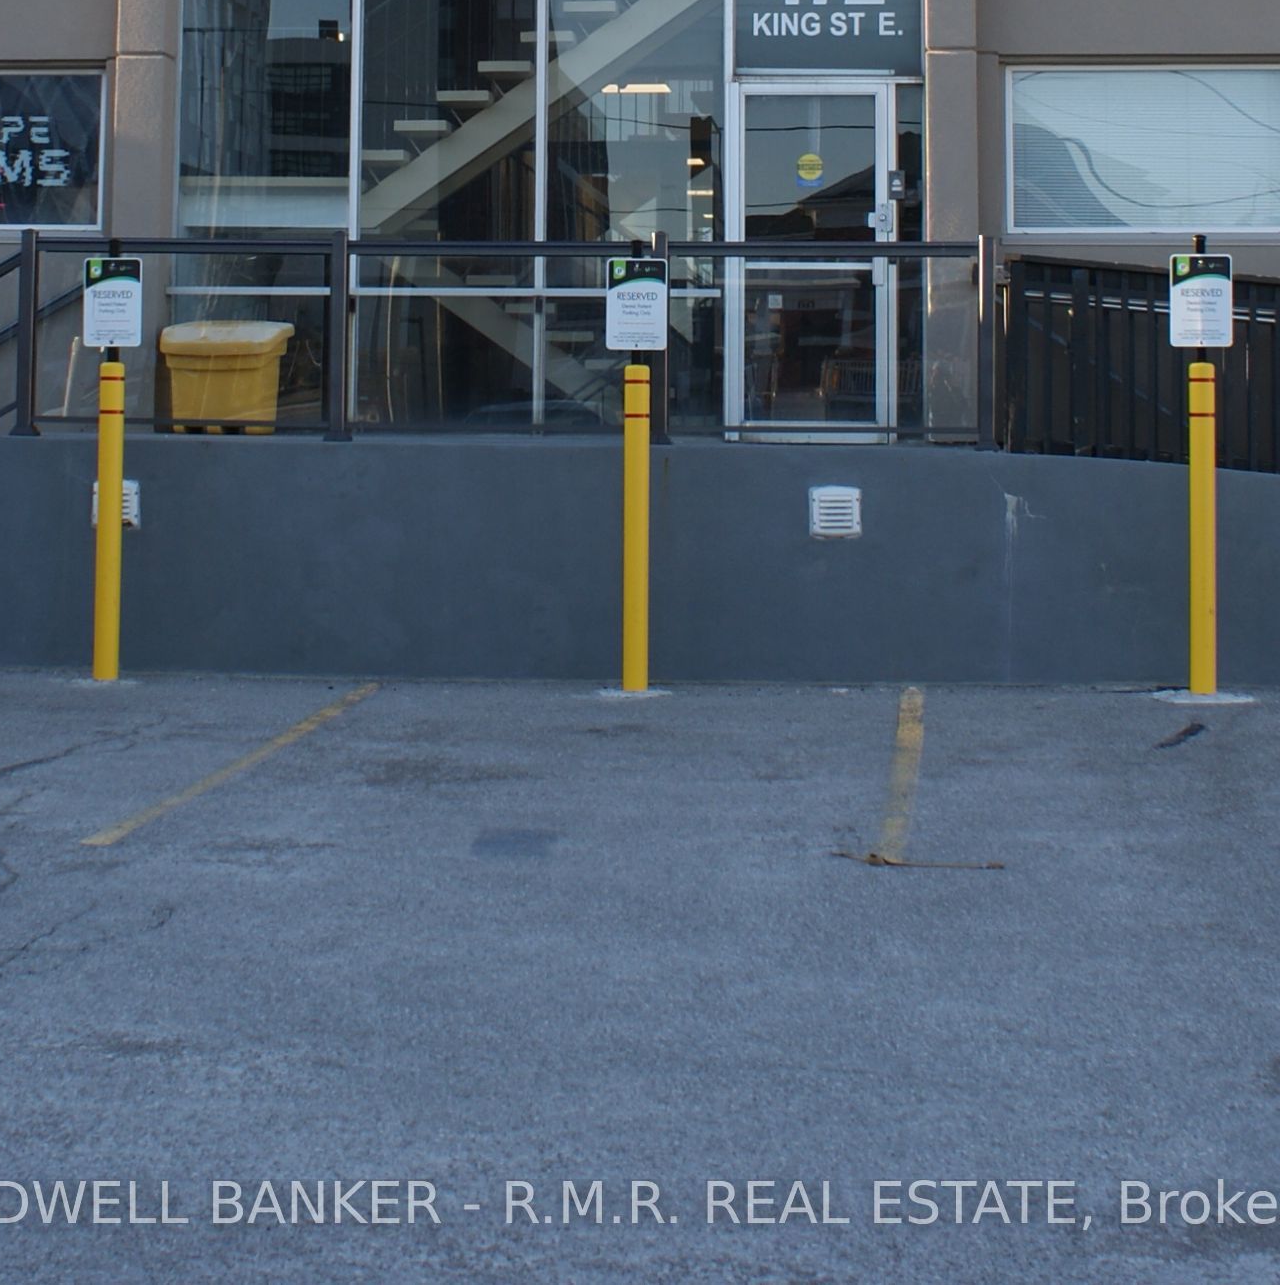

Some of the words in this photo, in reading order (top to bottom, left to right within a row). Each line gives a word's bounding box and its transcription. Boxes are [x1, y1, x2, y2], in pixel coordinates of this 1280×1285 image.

[753, 12, 821, 37] KING
[830, 11, 865, 36] ST
[878, 12, 904, 36] E.
[92, 290, 133, 299] RESERVED
[616, 291, 658, 301] RESERVED
